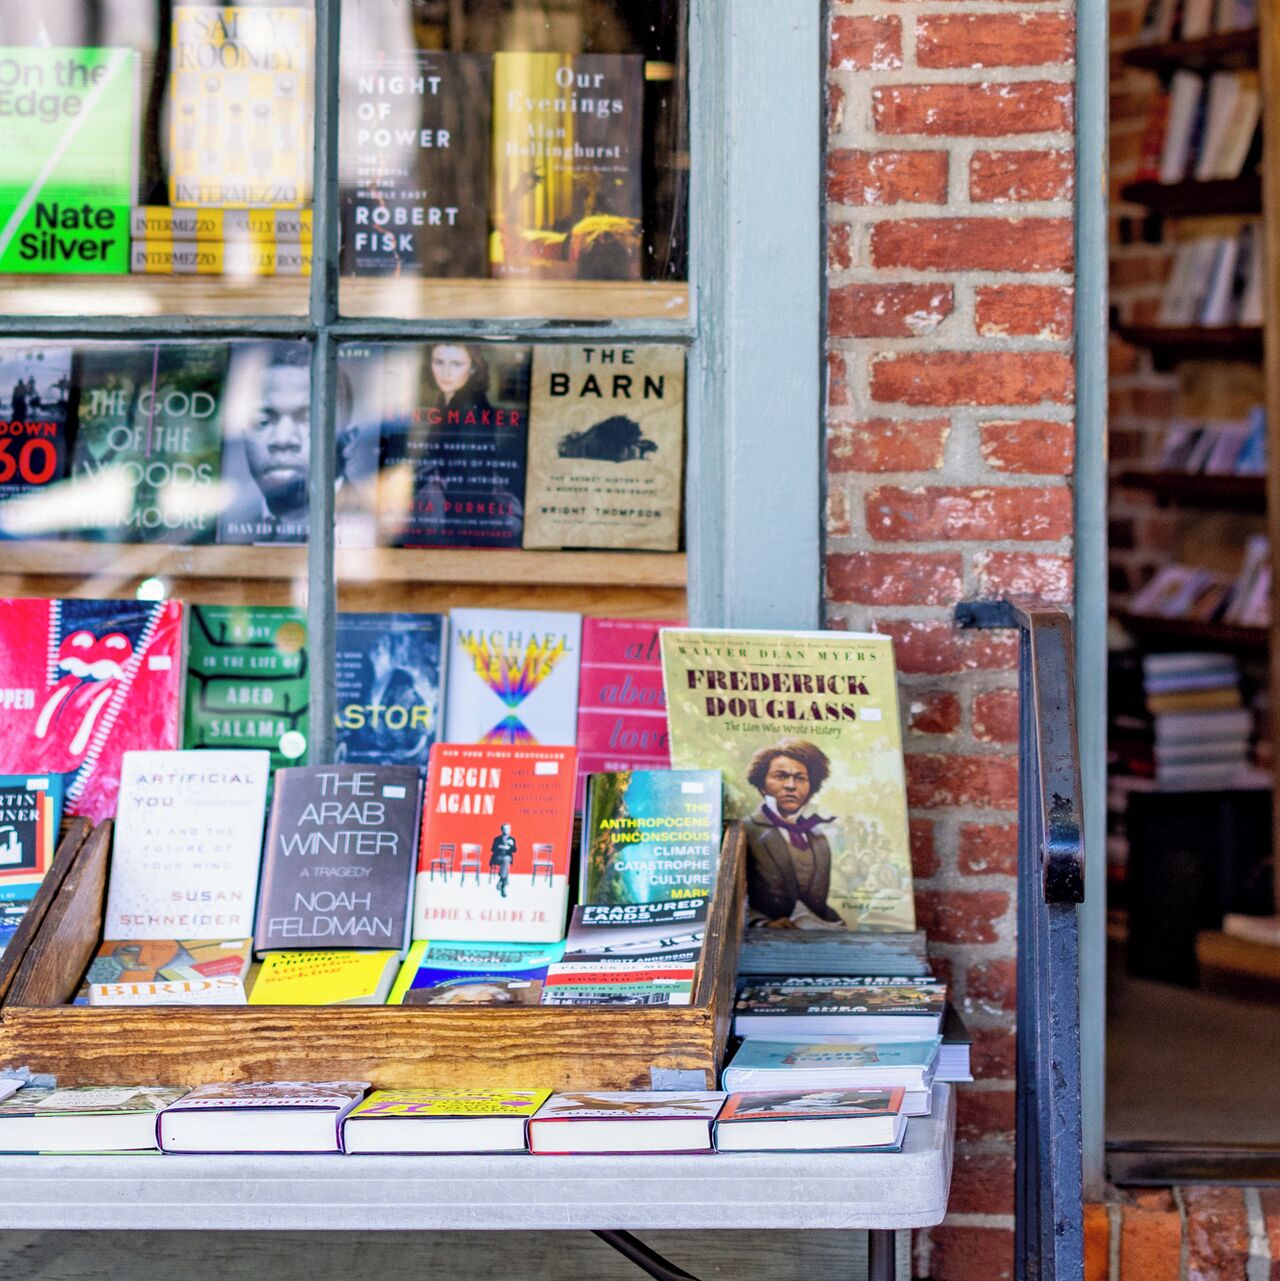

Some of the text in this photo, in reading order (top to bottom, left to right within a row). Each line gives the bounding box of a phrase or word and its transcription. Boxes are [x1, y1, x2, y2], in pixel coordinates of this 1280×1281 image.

[54, 59, 108, 87] the
[555, 67, 604, 89] Our
[358, 76, 441, 95] NIGHT
[358, 103, 391, 121] OF
[506, 91, 624, 119] Evenings
[357, 129, 450, 149] POWER
[527, 124, 566, 138] Alan
[505, 142, 621, 159] Hollinghurst
[176, 185, 298, 203] INTERMEZZO
[35, 203, 115, 230] Nate
[355, 207, 459, 225] ROBERT
[136, 218, 216, 233] INTERMEZZO
[19, 233, 115, 261] Silver
[354, 233, 414, 252] FISK
[136, 252, 216, 267] INTERMEZZO
[583, 348, 635, 365] THE
[550, 373, 665, 400] BARN
[89, 391, 215, 419] THE GOD
[108, 426, 192, 453] OF THE
[541, 506, 662, 519] WRIGHT THOMPSON
[456, 627, 575, 653] MICHAEL
[203, 655, 300, 670] IN THE LIFE OF
[678, 646, 878, 662] WALTER DEAN MYERS
[472, 654, 555, 674] LEWIS
[685, 669, 871, 696] FREDERICK
[226, 687, 275, 706] ABED
[705, 696, 857, 722] DOUGLASS
[210, 719, 287, 739] SALAMA
[724, 721, 843, 740] The Lion Who Wrote History
[135, 773, 255, 785] ARTIFICIAL
[315, 772, 377, 796] THE
[439, 766, 502, 789] BEGIN
[133, 796, 174, 808] YOU
[435, 793, 496, 816] AGAIN
[684, 802, 710, 814] THE
[296, 801, 385, 826] ARAB
[168, 827, 198, 836] AND
[206, 827, 235, 836] THE
[599, 817, 711, 830] ANTHROPOCENE
[280, 831, 400, 856] WINTER
[610, 831, 711, 844] UNCONSCIOUS
[143, 844, 232, 853] FUTURE OF
[652, 845, 710, 857] CLIMATE
[141, 861, 232, 871] YOUR MIND
[299, 866, 373, 878] A TRAGEDY
[614, 859, 710, 871] CATASTROPHE
[649, 873, 711, 885] CULTURE
[170, 890, 242, 902] SUSAN
[294, 891, 372, 912] NOAH
[671, 888, 710, 899] MARK
[424, 907, 459, 920] EDDIE
[480, 910, 526, 923] GLAUDE
[528, 911, 549, 923] JR.
[581, 910, 651, 922] LANDS
[584, 899, 704, 915] FRACTURED
[119, 914, 240, 926] SCHNEIDER
[268, 917, 393, 939] FELDMAN
[456, 955, 501, 965] Work
[636, 951, 694, 963] ANDERSON
[99, 976, 239, 998] BIRDS
